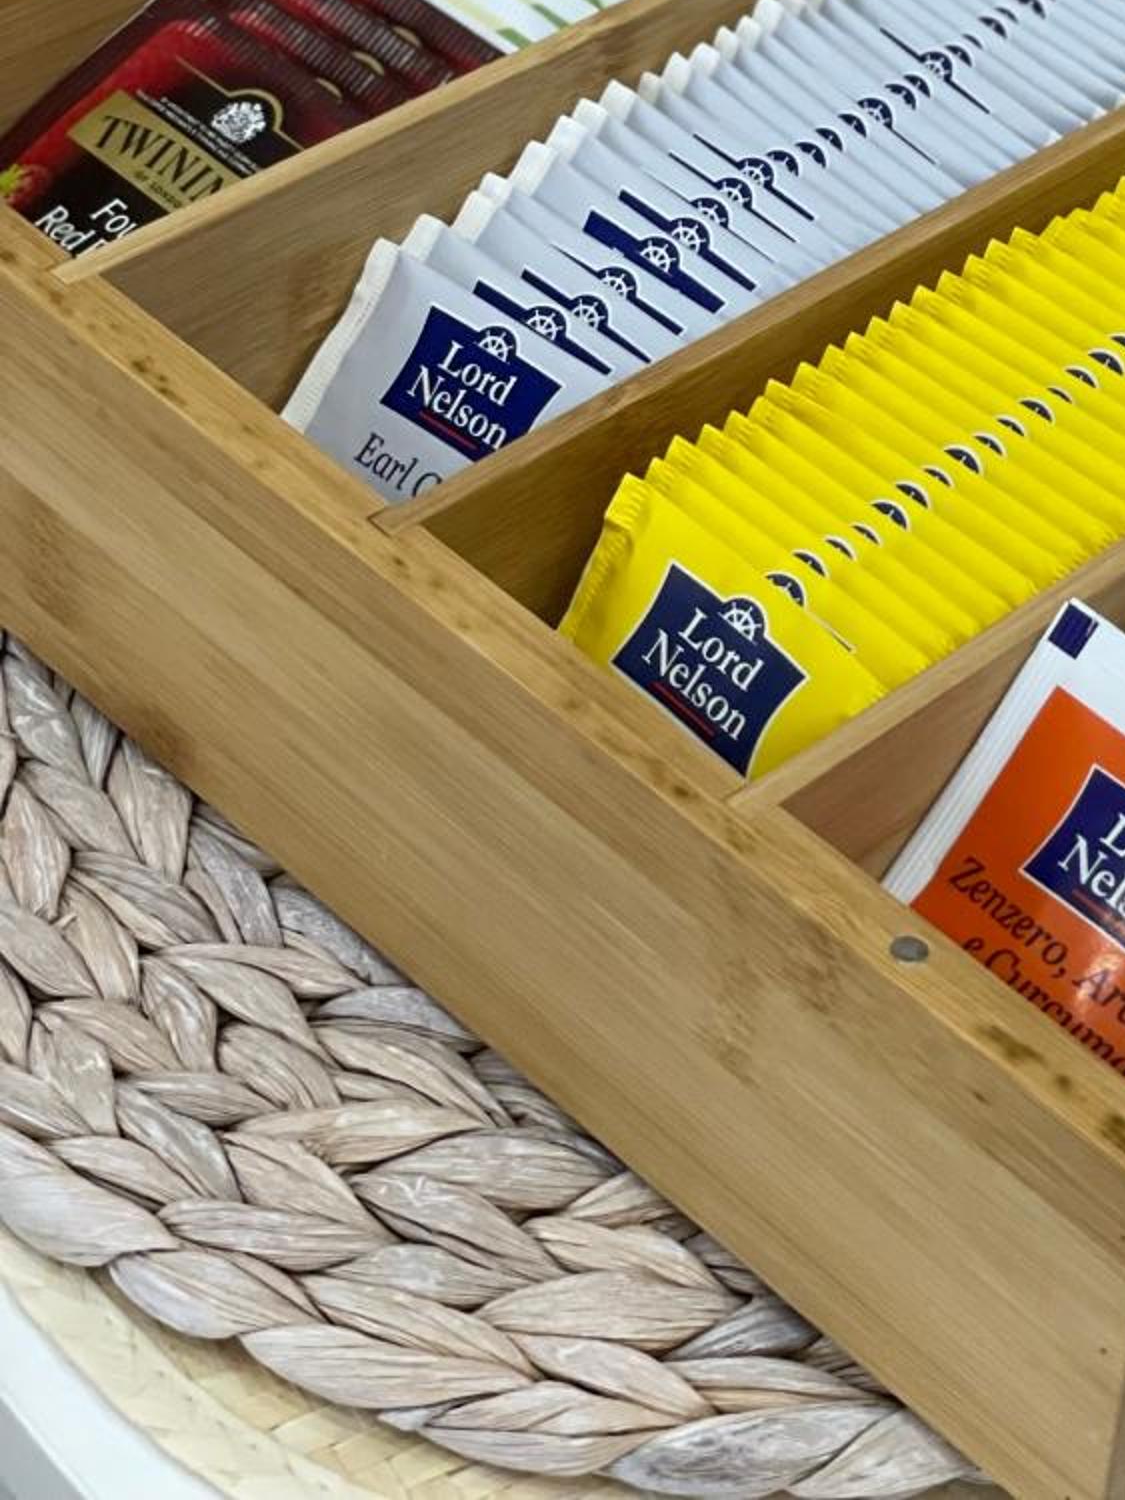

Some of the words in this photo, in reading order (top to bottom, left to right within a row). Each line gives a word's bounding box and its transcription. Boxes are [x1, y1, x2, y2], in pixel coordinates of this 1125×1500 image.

[35, 204, 97, 251] Red
[407, 366, 508, 450] Nelson
[437, 340, 518, 407] Lord
[353, 432, 419, 491] Earl
[641, 628, 747, 741] Nelson
[677, 608, 765, 691] Lord
[949, 856, 1069, 979] Zenzero,
